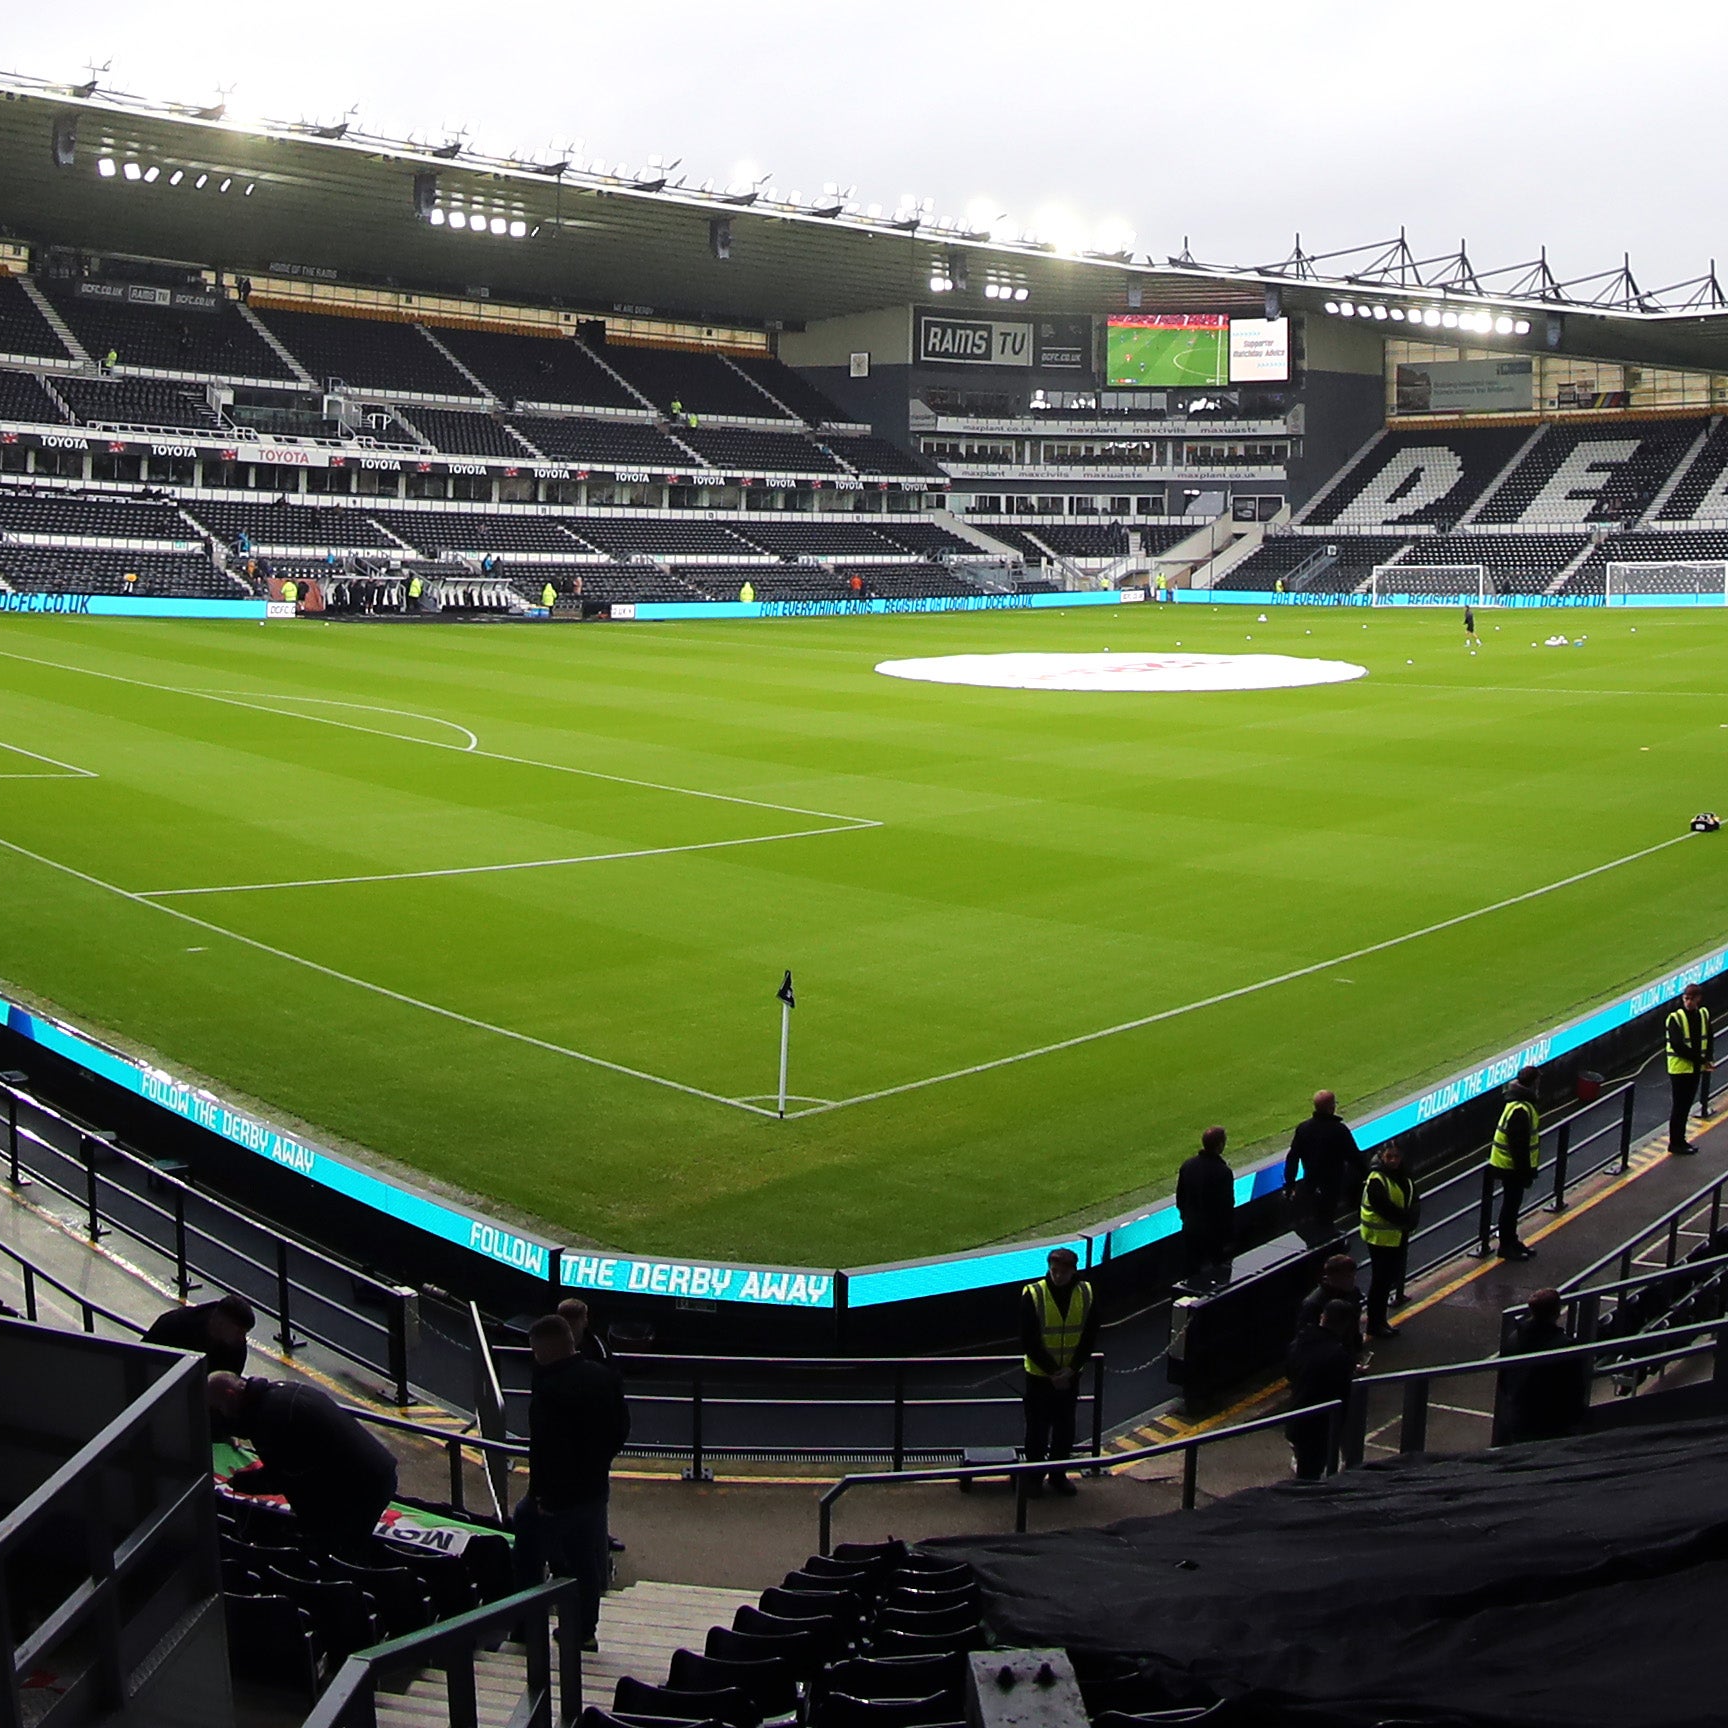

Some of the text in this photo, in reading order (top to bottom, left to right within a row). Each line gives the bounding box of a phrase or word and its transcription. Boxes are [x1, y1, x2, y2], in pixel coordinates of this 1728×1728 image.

[927, 326, 1026, 355] RAMS TV
[1066, 426, 1118, 435] maxplant
[1200, 426, 1258, 434] maxwaste
[41, 435, 88, 450] TOYOTA
[151, 444, 197, 458] TOYOTA
[258, 449, 310, 465] TOYOTA
[360, 459, 401, 471] TOYOTA
[448, 464, 487, 476] TOYOTA
[533, 469, 570, 480] TOYOTA
[615, 472, 650, 483] TOYOTA
[961, 469, 1006, 478] maxplant
[1083, 471, 1143, 479] maxwaste
[692, 475, 725, 486] TOYOTA
[765, 478, 796, 488] TOYOTA
[835, 480, 864, 491] TOYOTA
[901, 482, 928, 492] TOYOTA
[1272, 592, 1290, 605] FOR
[1294, 593, 1358, 607] EVERYTHING
[1407, 593, 1460, 606] REGISTER
[759, 601, 774, 617] FOR
[782, 600, 841, 616] EVERYTHING
[884, 597, 927, 613] REGISTER
[930, 596, 943, 612] OR
[946, 596, 969, 611] LOGIN
[1417, 1037, 1552, 1122] FOLLOW THE DERBY AWAY
[142, 1074, 315, 1174] FOLLOW THE DERBY AWAY
[470, 1221, 831, 1303] FOLLOW THE DERBY AWAY
